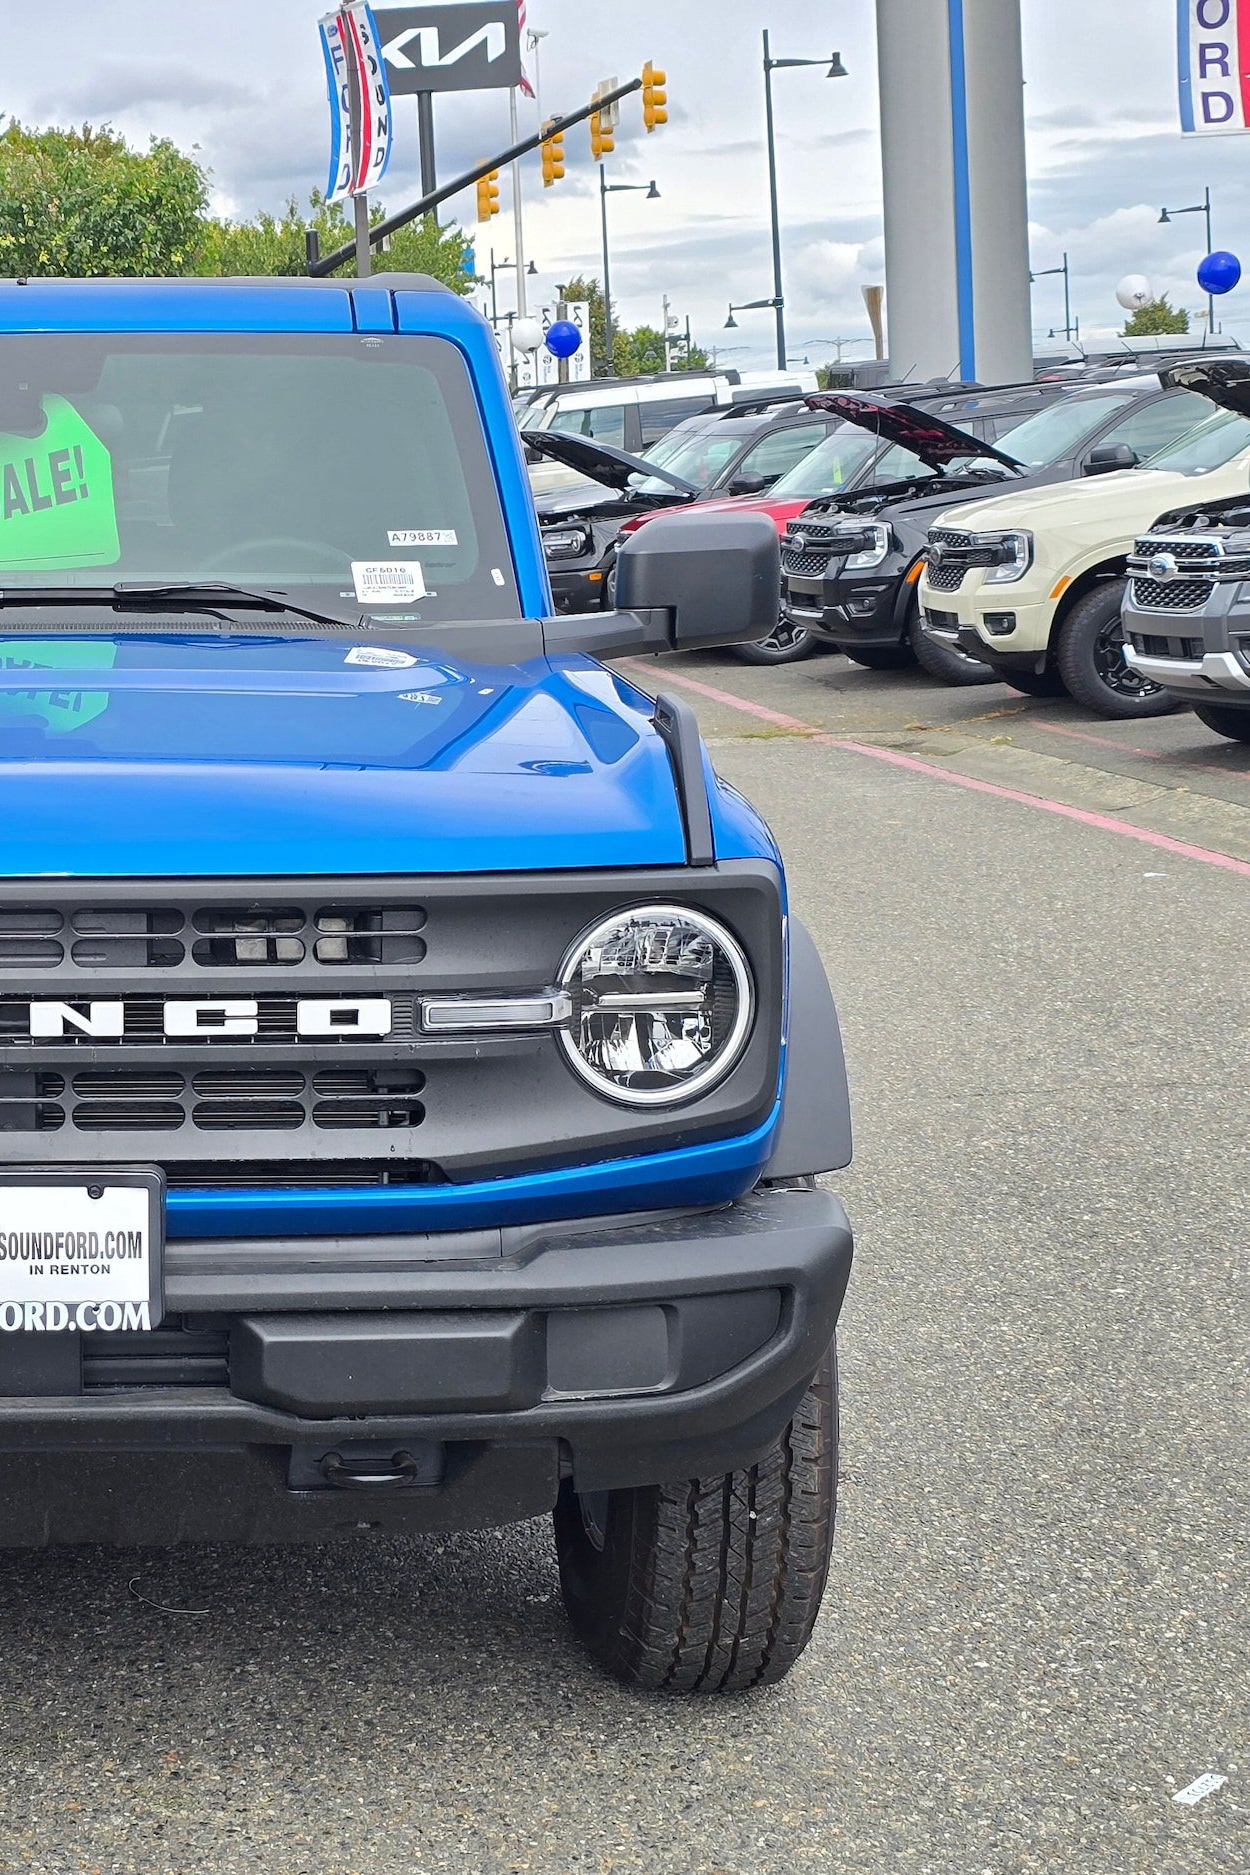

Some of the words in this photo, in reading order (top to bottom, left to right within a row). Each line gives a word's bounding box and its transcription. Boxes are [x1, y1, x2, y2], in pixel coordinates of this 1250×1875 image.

[392, 532, 440, 541] A79887
[29, 1265, 43, 1275] IN
[50, 1264, 111, 1276] RENTON
